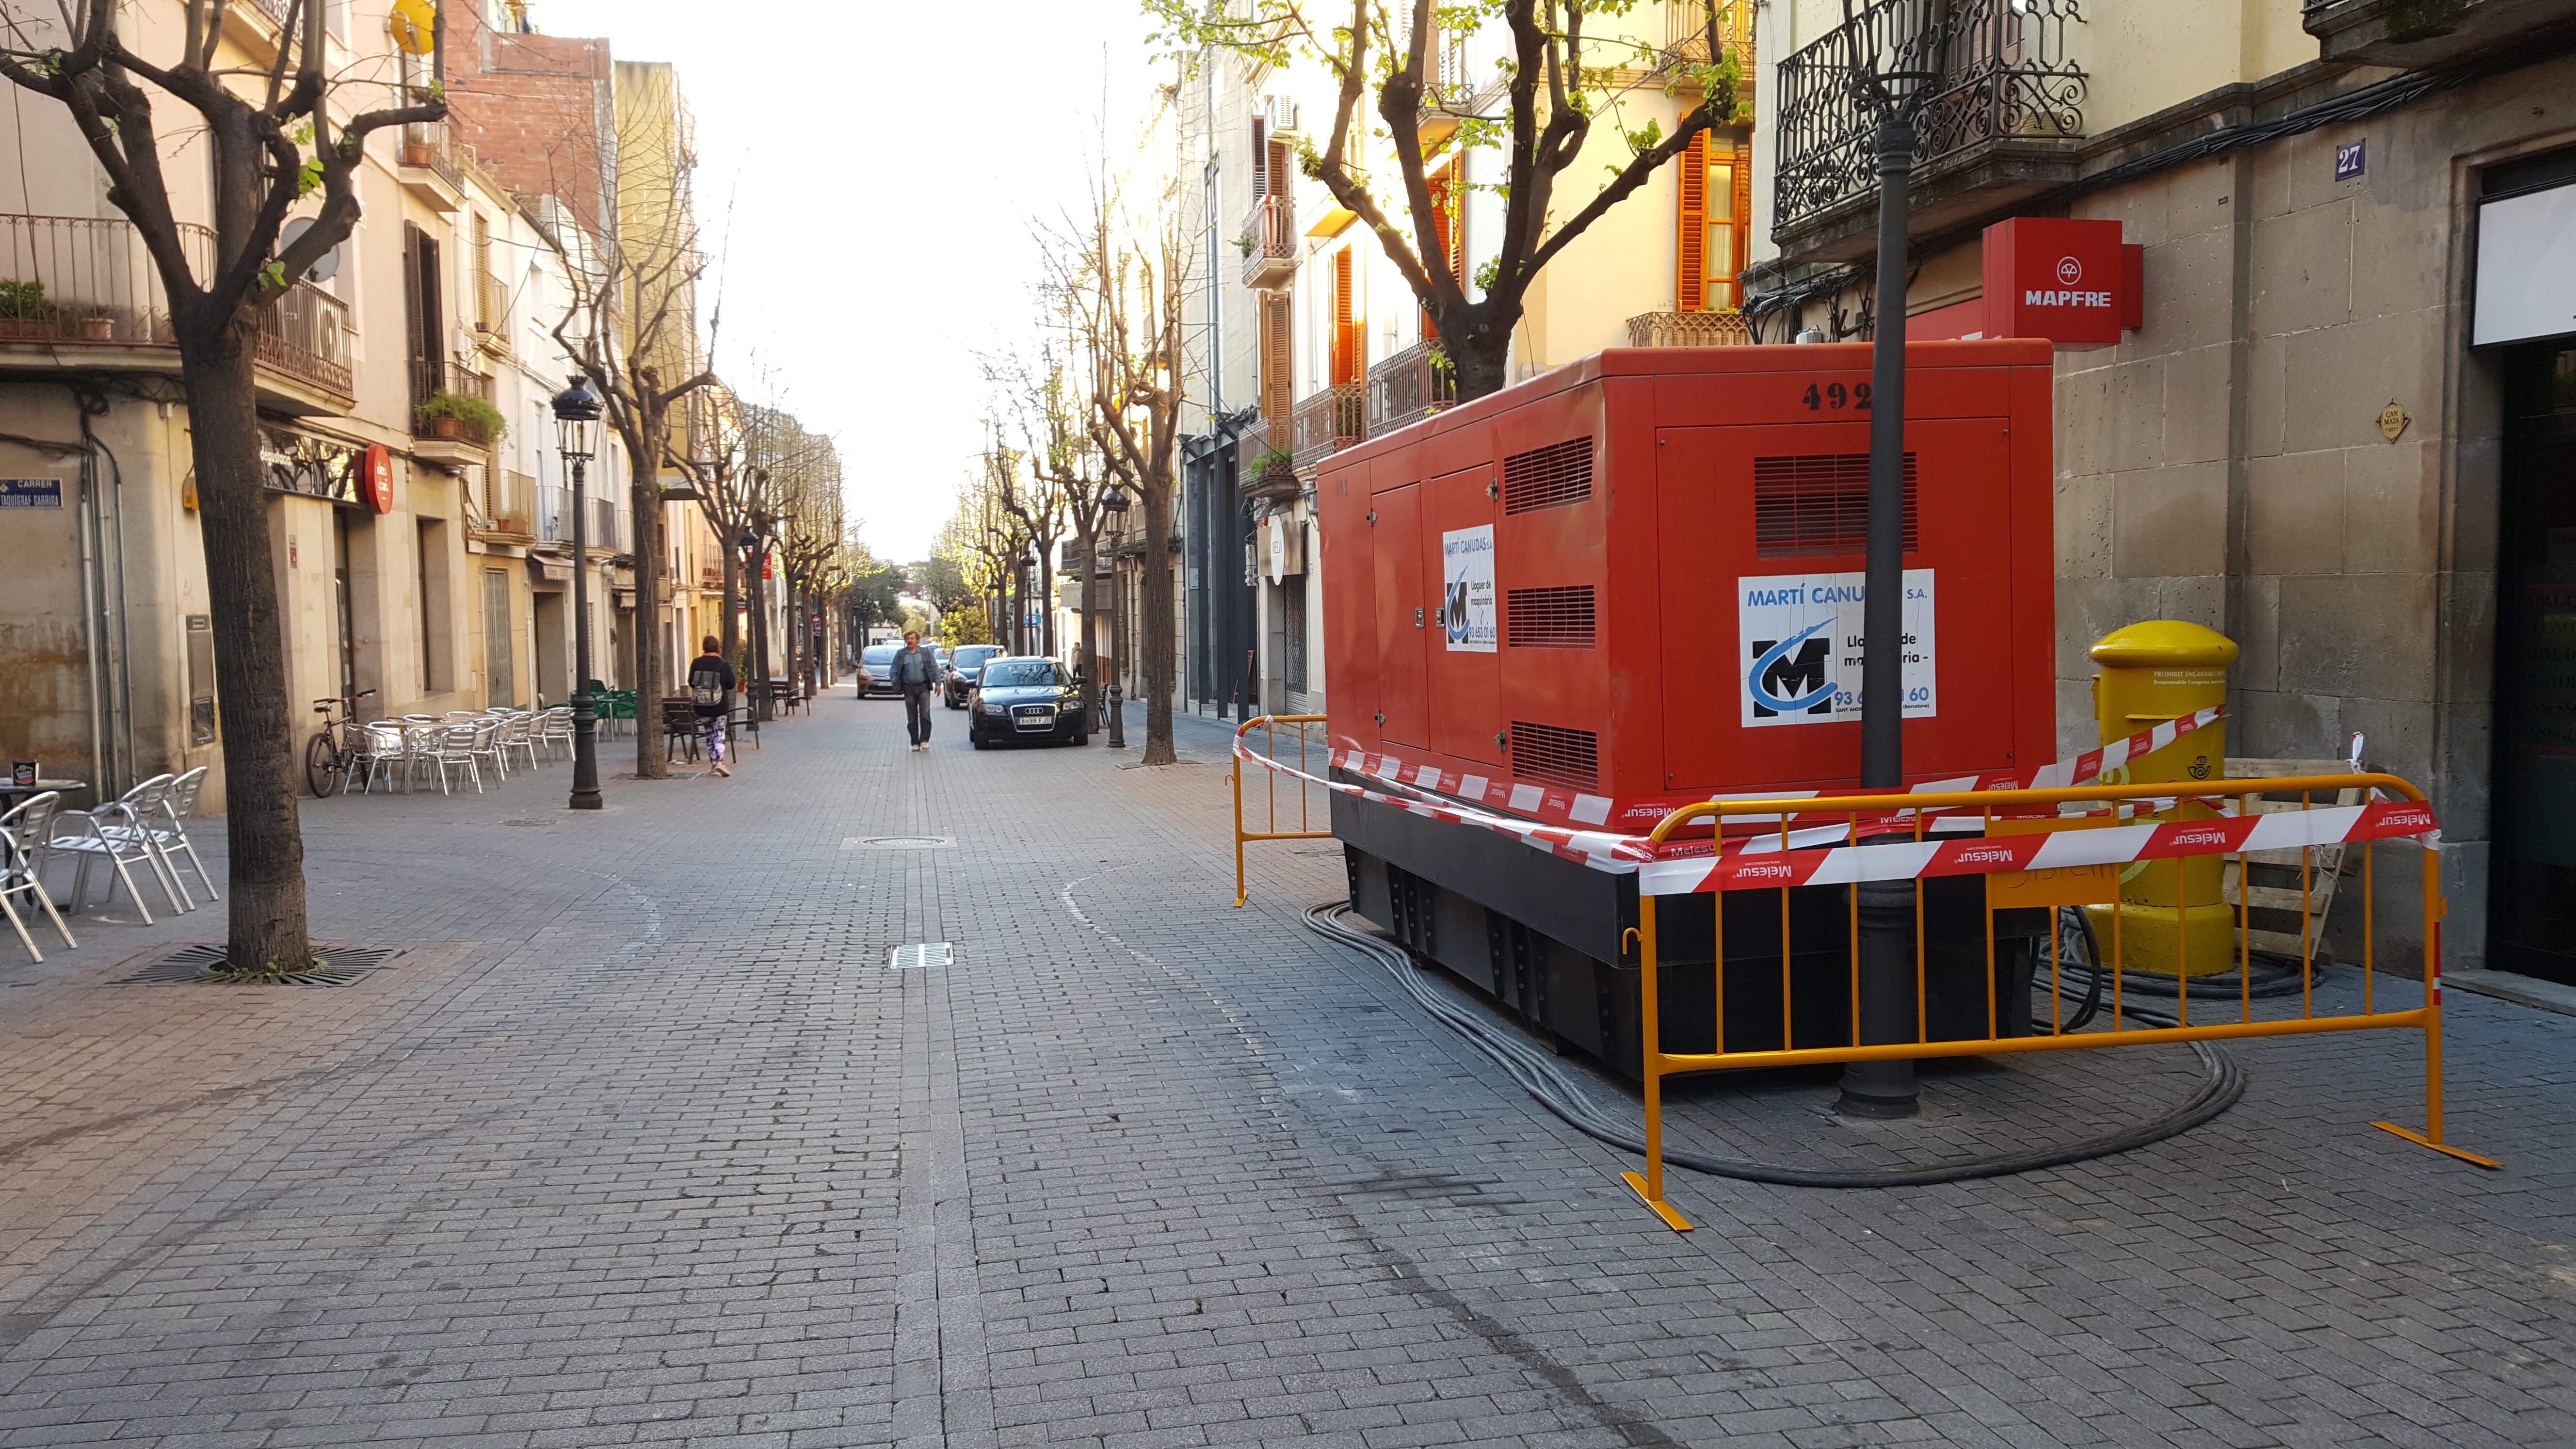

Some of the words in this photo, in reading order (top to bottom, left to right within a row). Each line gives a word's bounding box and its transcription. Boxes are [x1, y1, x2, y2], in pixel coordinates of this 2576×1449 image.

[2338, 145, 2361, 173] 27
[2026, 290, 2111, 307] MAPFRE
[1802, 383, 1872, 410] 492
[17, 479, 52, 488] CARRER
[33, 495, 59, 506] GARRIGA
[1445, 536, 1459, 556] MARTÍ
[1461, 537, 1486, 553] CANUDAS
[1471, 580, 1485, 593] Lloguer
[1486, 579, 1491, 589] de
[1747, 583, 1805, 607] MARTÍ
[1812, 585, 1865, 604] CANU
[1907, 589, 1927, 599] S.A.
[1469, 627, 1474, 638] 93
[1490, 626, 1496, 638] 60
[1901, 632, 1916, 644] de
[1834, 691, 1852, 706] 93
[1909, 687, 1929, 702] 60
[2379, 814, 2431, 826] Melesur
[2173, 832, 2226, 844] Melesur
[1671, 845, 1716, 857] Melesu
[1958, 850, 2012, 863] Melesur
[1736, 866, 1791, 878] Melesur
